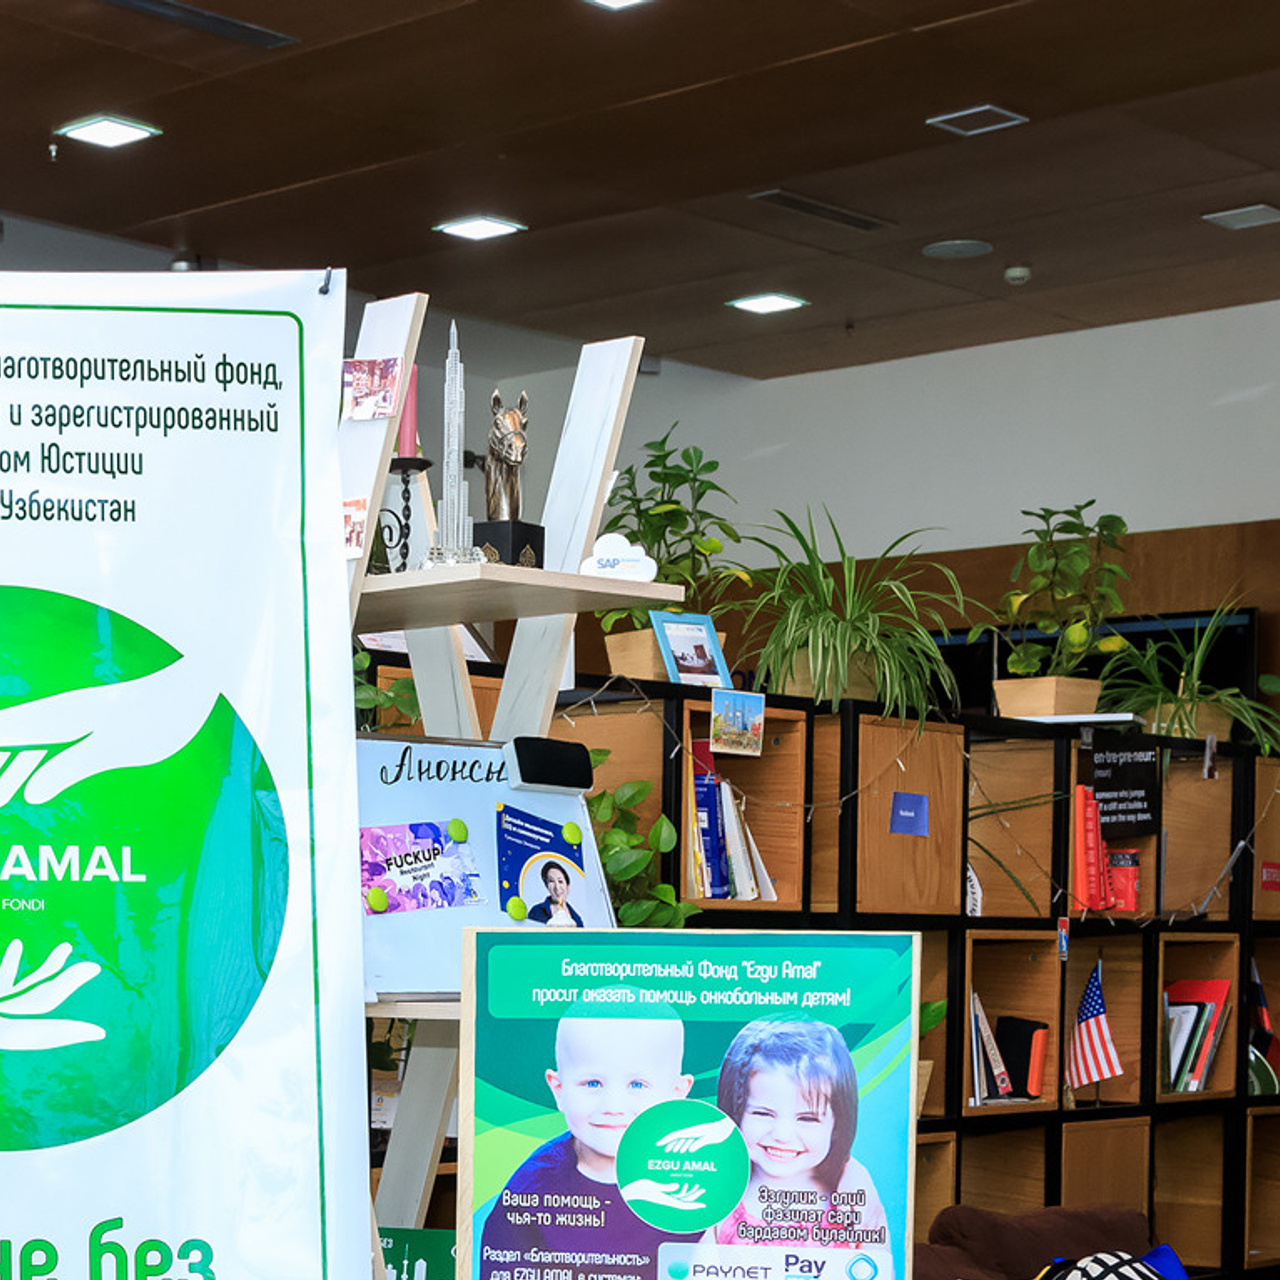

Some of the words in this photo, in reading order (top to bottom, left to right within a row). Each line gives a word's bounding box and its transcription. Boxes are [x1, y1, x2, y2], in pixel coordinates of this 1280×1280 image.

[215, 353, 284, 392] фонд,
[10, 404, 22, 427] и
[31, 403, 279, 437] зарегистрированный
[40, 443, 144, 480] Юстиции
[0, 489, 136, 522] Узбекистан
[597, 557, 620, 569] SAP
[0, 845, 147, 883] AMAL
[386, 847, 441, 871] FUCKUP
[2, 898, 45, 911] FONDI
[561, 958, 694, 980] Благотворительный
[697, 959, 738, 980] Фонд
[532, 988, 579, 1006] просит
[582, 988, 636, 1003] оказать
[639, 988, 697, 1006] помощь
[700, 987, 798, 1005] онкобольным
[801, 988, 851, 1008] детям!
[647, 1159, 680, 1171] EZGU
[682, 1160, 718, 1172] AMAL
[502, 1189, 540, 1207] Ваша
[543, 1194, 601, 1210] помощь
[758, 1186, 818, 1207] Эзгулик
[831, 1188, 866, 1207] олий
[506, 1211, 552, 1226] чья-то
[555, 1211, 606, 1227] жизнь!
[762, 1205, 823, 1225] фазилат
[827, 1209, 862, 1226] сари
[737, 1221, 809, 1243] бардавом
[482, 1246, 521, 1263] Раздел
[523, 1247, 651, 1266] «Благотворительность»
[784, 1253, 826, 1279] Pay
